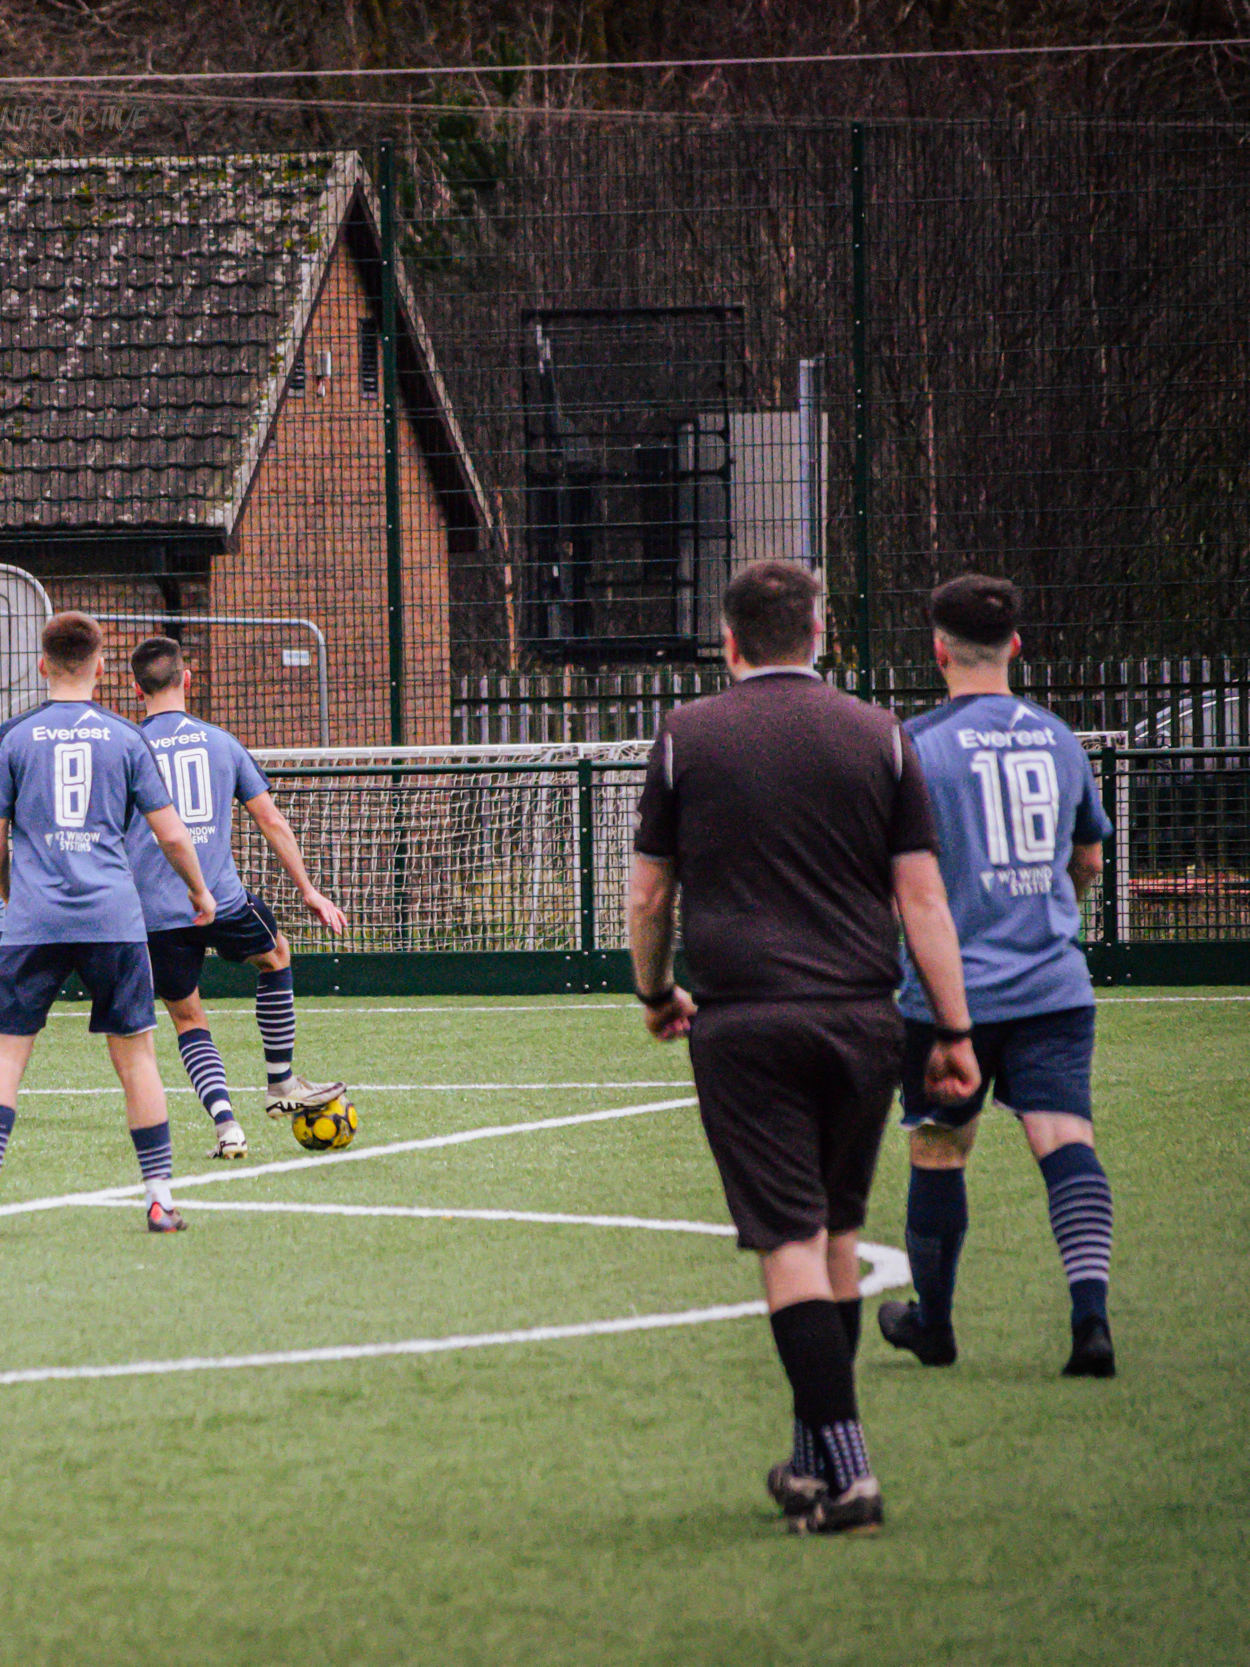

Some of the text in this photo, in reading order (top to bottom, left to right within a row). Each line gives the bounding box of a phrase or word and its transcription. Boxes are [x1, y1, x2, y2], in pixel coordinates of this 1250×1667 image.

[32, 726, 111, 741] Everest
[149, 730, 208, 749] verest
[958, 727, 1057, 749] Everest
[54, 742, 92, 827] 8
[970, 750, 1060, 863] 18
[189, 825, 216, 836] NDOW
